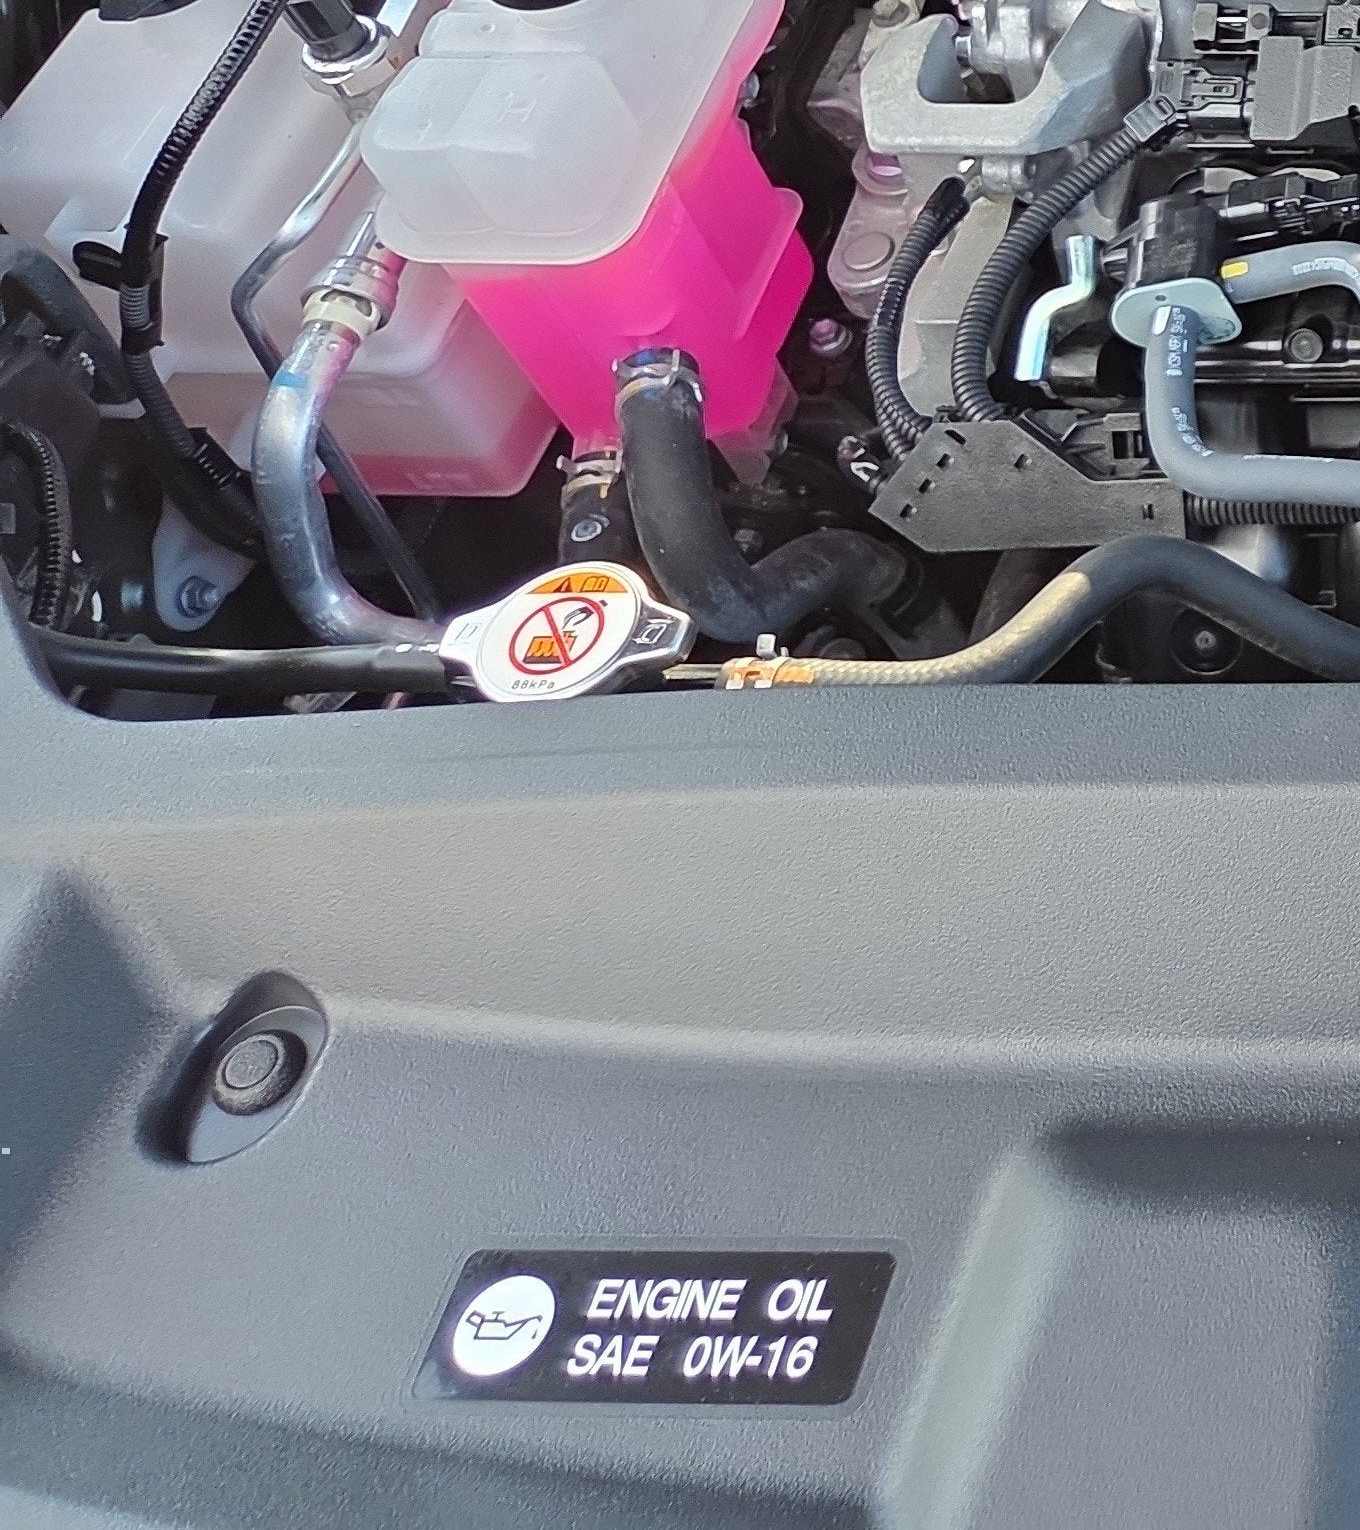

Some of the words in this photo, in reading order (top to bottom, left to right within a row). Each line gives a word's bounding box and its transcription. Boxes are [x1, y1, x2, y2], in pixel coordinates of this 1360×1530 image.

[511, 679, 555, 690] 88kPa
[586, 1278, 748, 1321] ENGINE
[767, 1278, 833, 1321] OIL
[567, 1334, 660, 1376] SAE
[682, 1334, 819, 1378] 0W-16
